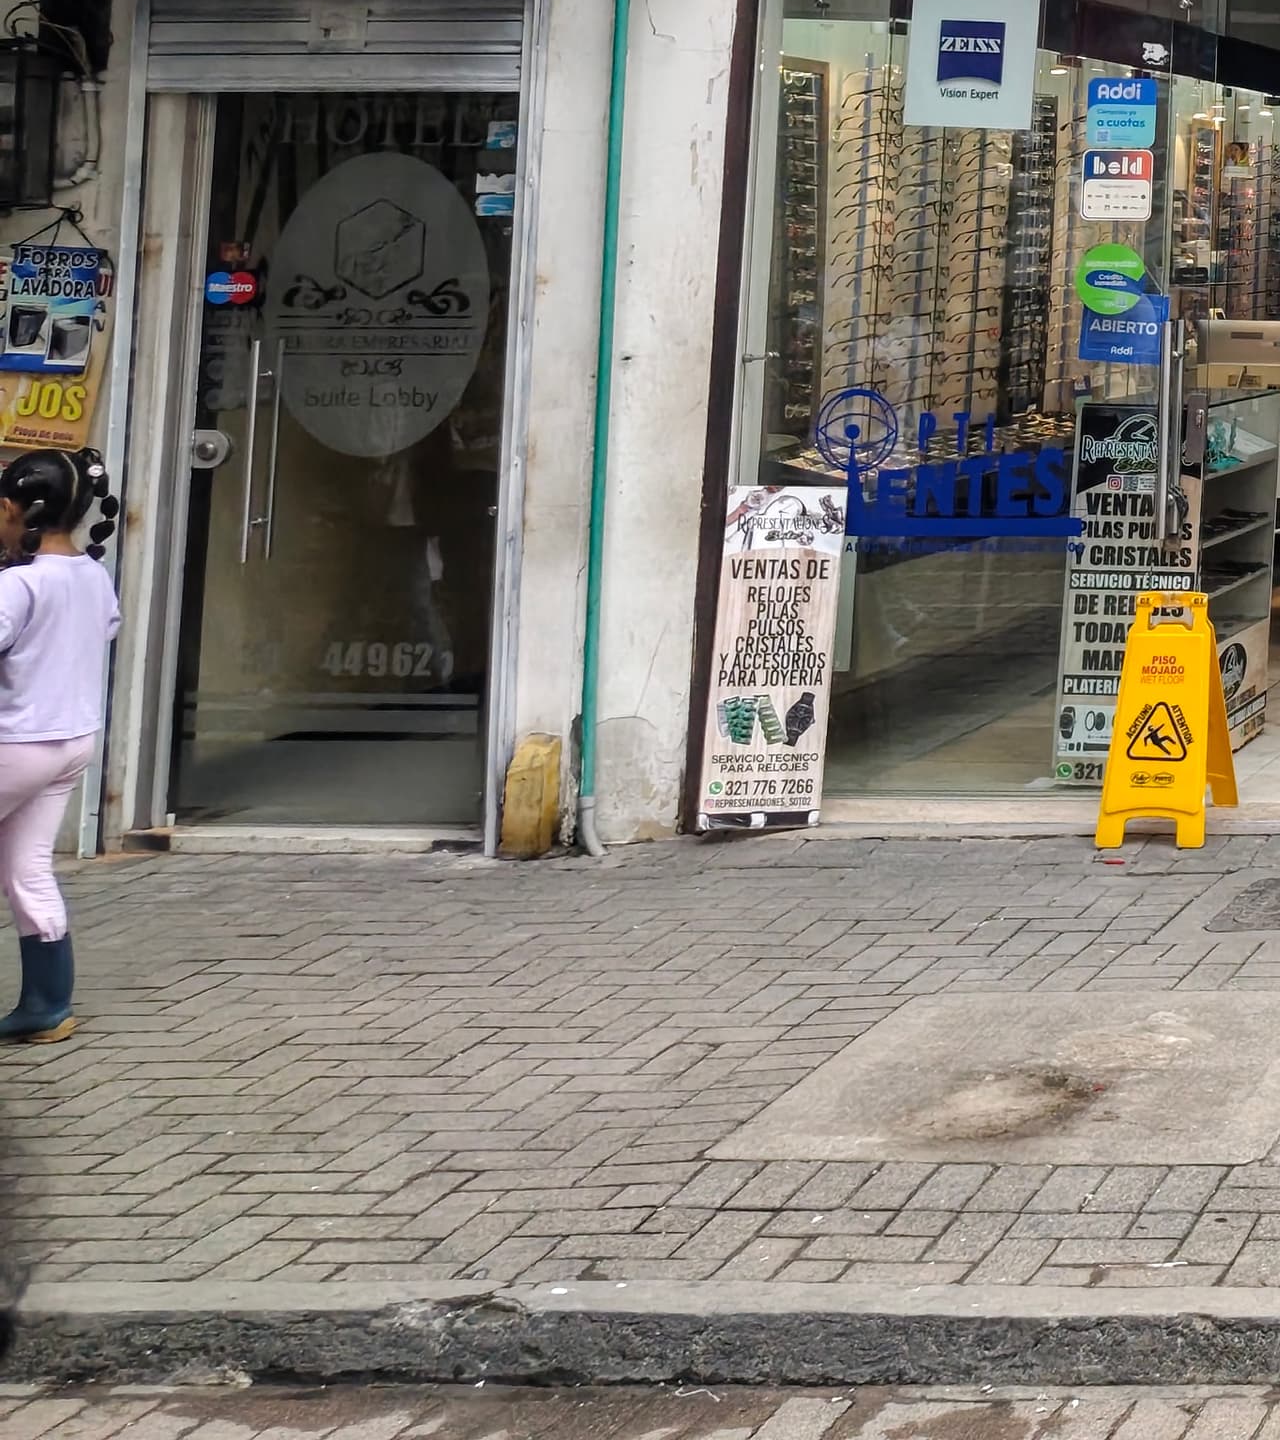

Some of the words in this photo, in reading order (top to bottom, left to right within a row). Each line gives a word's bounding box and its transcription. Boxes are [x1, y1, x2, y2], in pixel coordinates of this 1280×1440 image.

[939, 36, 1002, 54] ZEISS
[939, 87, 967, 100] Vision
[969, 88, 999, 102] Expert
[1097, 83, 1141, 101] Addi
[1106, 117, 1146, 129] cuotas
[17, 247, 99, 268] FORROS
[11, 277, 95, 298] LAVADORA
[1089, 318, 1159, 336] ABIERTO
[1110, 345, 1133, 356] Addi
[1090, 545, 1192, 568] CRISTALES
[731, 559, 800, 580] VENTAS
[807, 559, 831, 580] DE
[1071, 572, 1133, 589] SERVICIO
[1135, 569, 1192, 590] TÉCNICO
[747, 586, 811, 604] RELOJES
[756, 602, 799, 620] PILAS
[1074, 594, 1100, 616] DE
[748, 619, 804, 637] PULSOS
[735, 636, 813, 654] CRISTALES
[719, 653, 728, 671] Y
[730, 652, 826, 671] ACCESORIOS
[1151, 655, 1177, 665] PISO
[718, 669, 759, 688] PARA
[1141, 665, 1185, 675] MOJADO
[1140, 675, 1158, 684] WET
[1158, 675, 1185, 685] FLOOR
[1125, 703, 1153, 739] ACHTUNG
[1170, 704, 1195, 746] ATTENTION
[712, 754, 764, 765] SERVICIO
[767, 752, 820, 764] TECNICO
[720, 763, 755, 773] PARA
[757, 762, 809, 773] RELOJES
[724, 780, 751, 797] 321
[753, 780, 778, 796] 776
[780, 779, 814, 795] 7266
